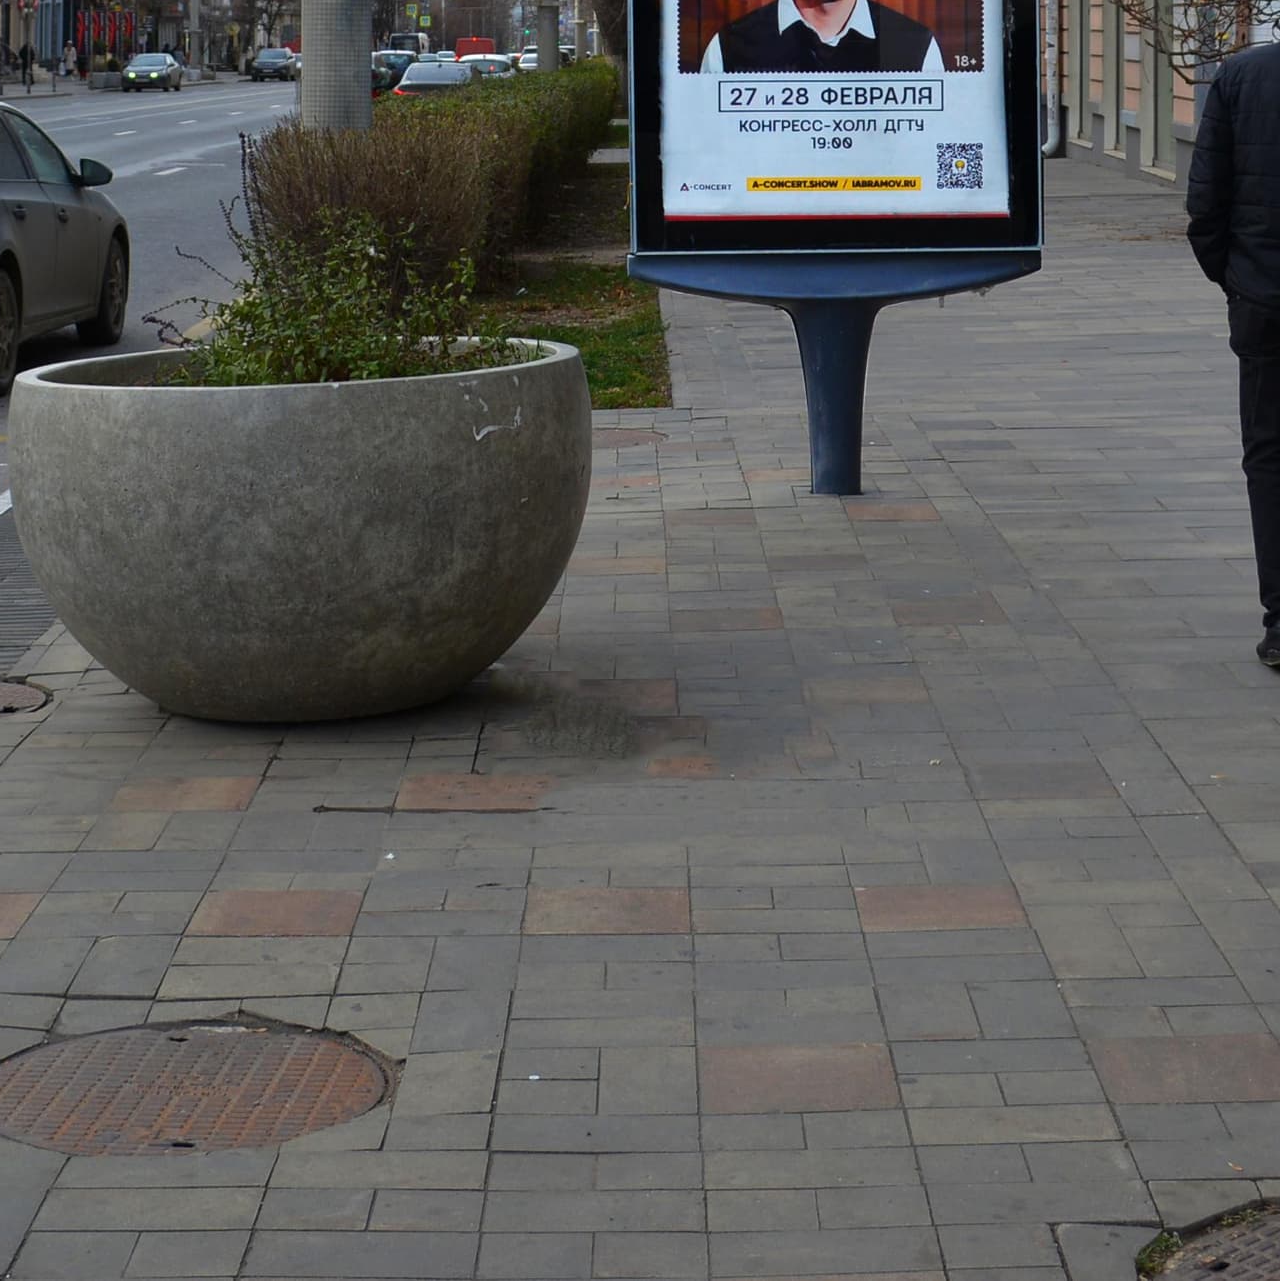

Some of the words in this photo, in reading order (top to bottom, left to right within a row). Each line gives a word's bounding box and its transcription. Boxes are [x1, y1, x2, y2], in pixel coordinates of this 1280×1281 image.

[954, 55, 977, 67] 18+
[730, 87, 758, 106] 27
[781, 87, 809, 105] 28
[820, 86, 933, 106] ФЕВРАЛЯ
[739, 119, 877, 132] КОНГРЕСС-ХОЛЛ
[883, 118, 925, 134] ДГТУ
[810, 136, 853, 150] 19:00
[752, 179, 839, 189] A-CONCERT.SHOW
[851, 179, 917, 188] IABRAMOV.RU
